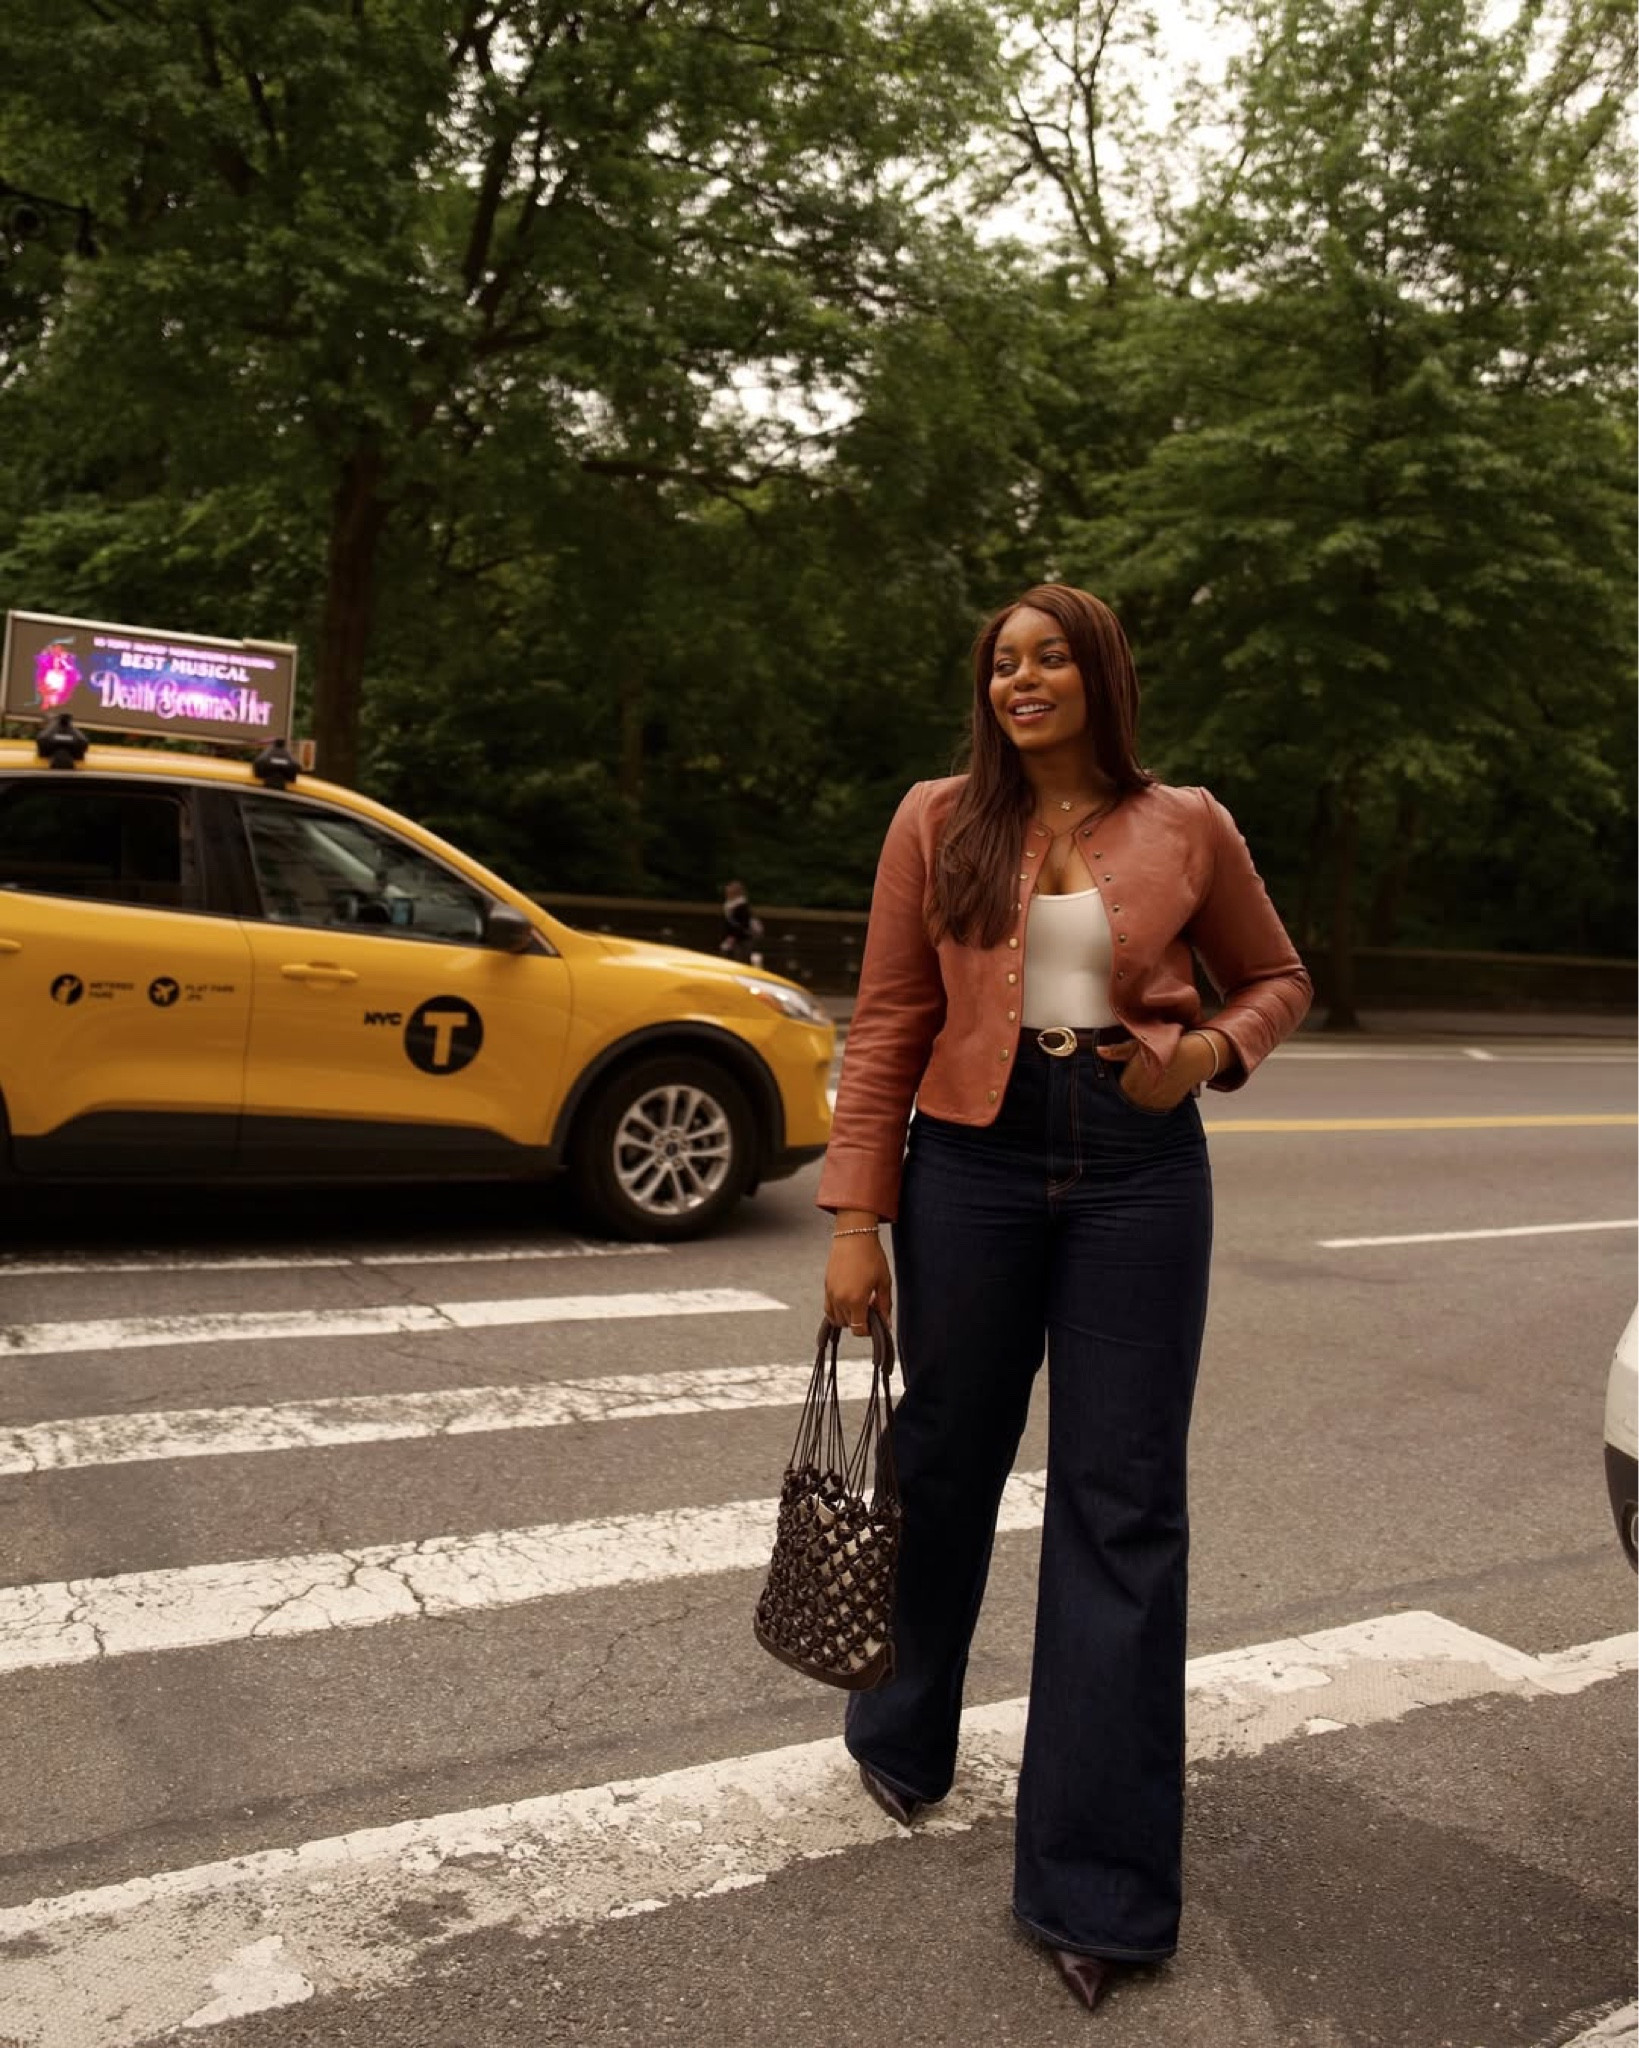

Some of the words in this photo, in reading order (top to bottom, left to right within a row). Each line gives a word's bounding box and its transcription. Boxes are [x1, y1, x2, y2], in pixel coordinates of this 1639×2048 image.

[120, 651, 166, 671] BEST
[169, 657, 250, 682] MUSICAL
[90, 670, 156, 711] Death
[155, 678, 238, 722] Becomes
[229, 688, 273, 726] Her
[364, 1011, 402, 1026] NYC
[424, 1011, 468, 1065] T
